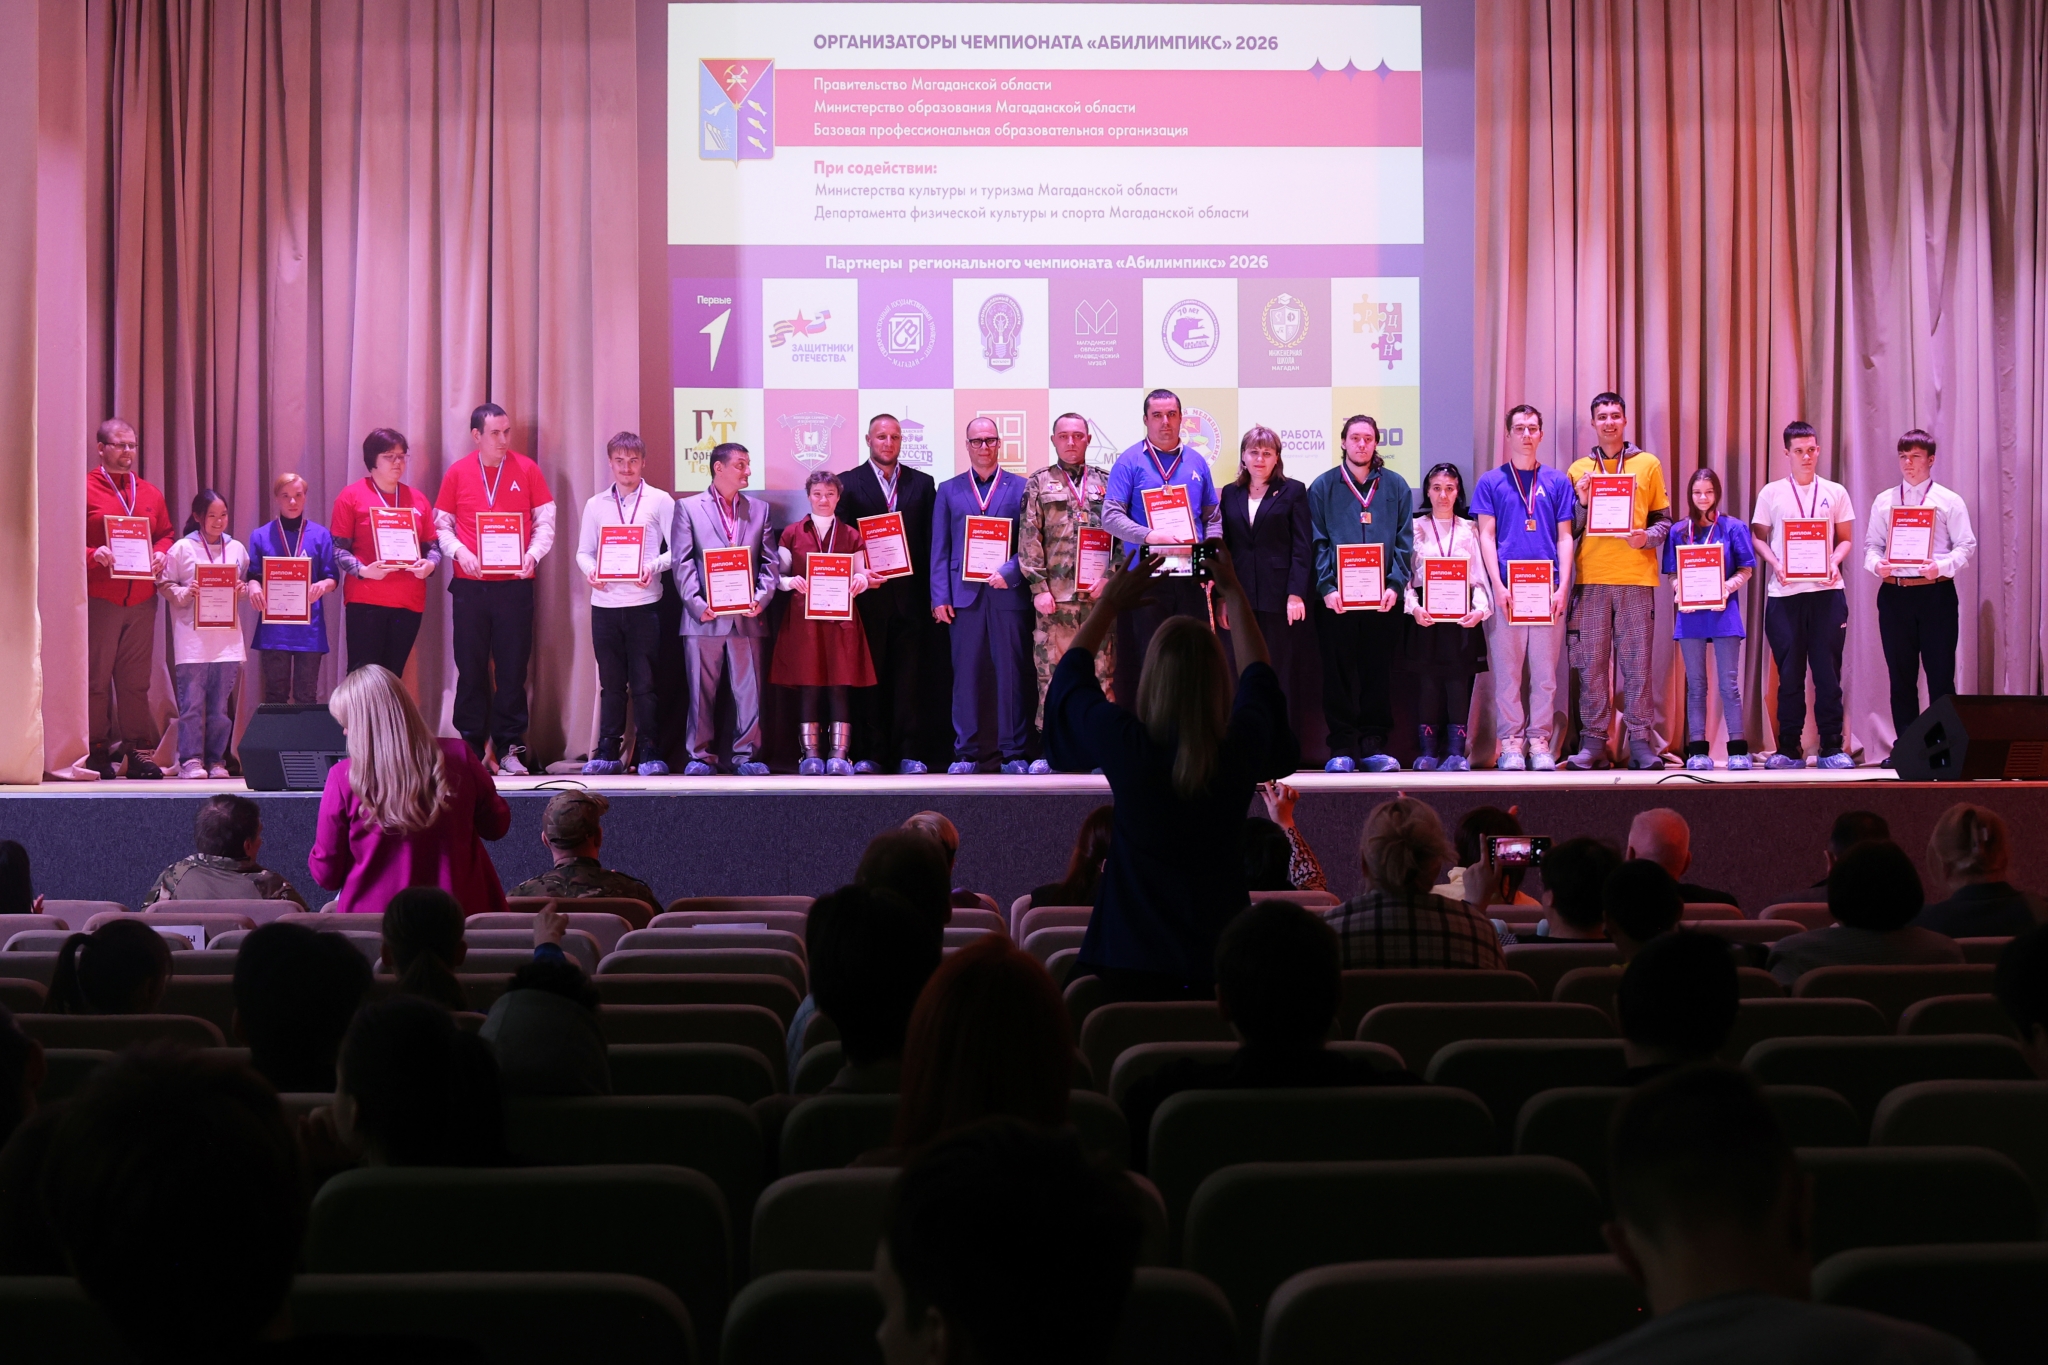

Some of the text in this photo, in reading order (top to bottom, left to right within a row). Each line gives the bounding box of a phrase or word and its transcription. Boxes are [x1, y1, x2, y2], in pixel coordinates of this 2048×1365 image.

[813, 34, 1279, 50] ОРГАНИЗАТОРЫ ЧЕМПИОНАТА «АБИЛИМПИКС» 2026
[813, 77, 1052, 93] Правительство Магаданской области
[813, 100, 1137, 116] Министерство образования Магаданской области
[813, 122, 1189, 139] Базовая профессиональная образовательная организация
[813, 161, 938, 178] При содействии:
[814, 182, 1178, 200] Министерства культуры и туризма Магаданской области
[814, 205, 1249, 223] Департамента физической культуры и спорта Магаданской области
[825, 255, 1269, 273] Партнеры регионального чемпионата «Абилимпикс» 2026
[697, 295, 732, 305] Первые
[1177, 307, 1187, 316] 70
[791, 343, 854, 353] ЗАЩИТНИКИ
[791, 353, 847, 362] ОТЕЧЕСТВА
[1280, 429, 1323, 439] РАБОТА
[1281, 441, 1325, 451] РОССИИ
[684, 448, 711, 464] Горн
[899, 450, 933, 463] УССТВ
[1151, 499, 1173, 507] ДИПЛОМ
[866, 527, 888, 536] ДИПЛОМ
